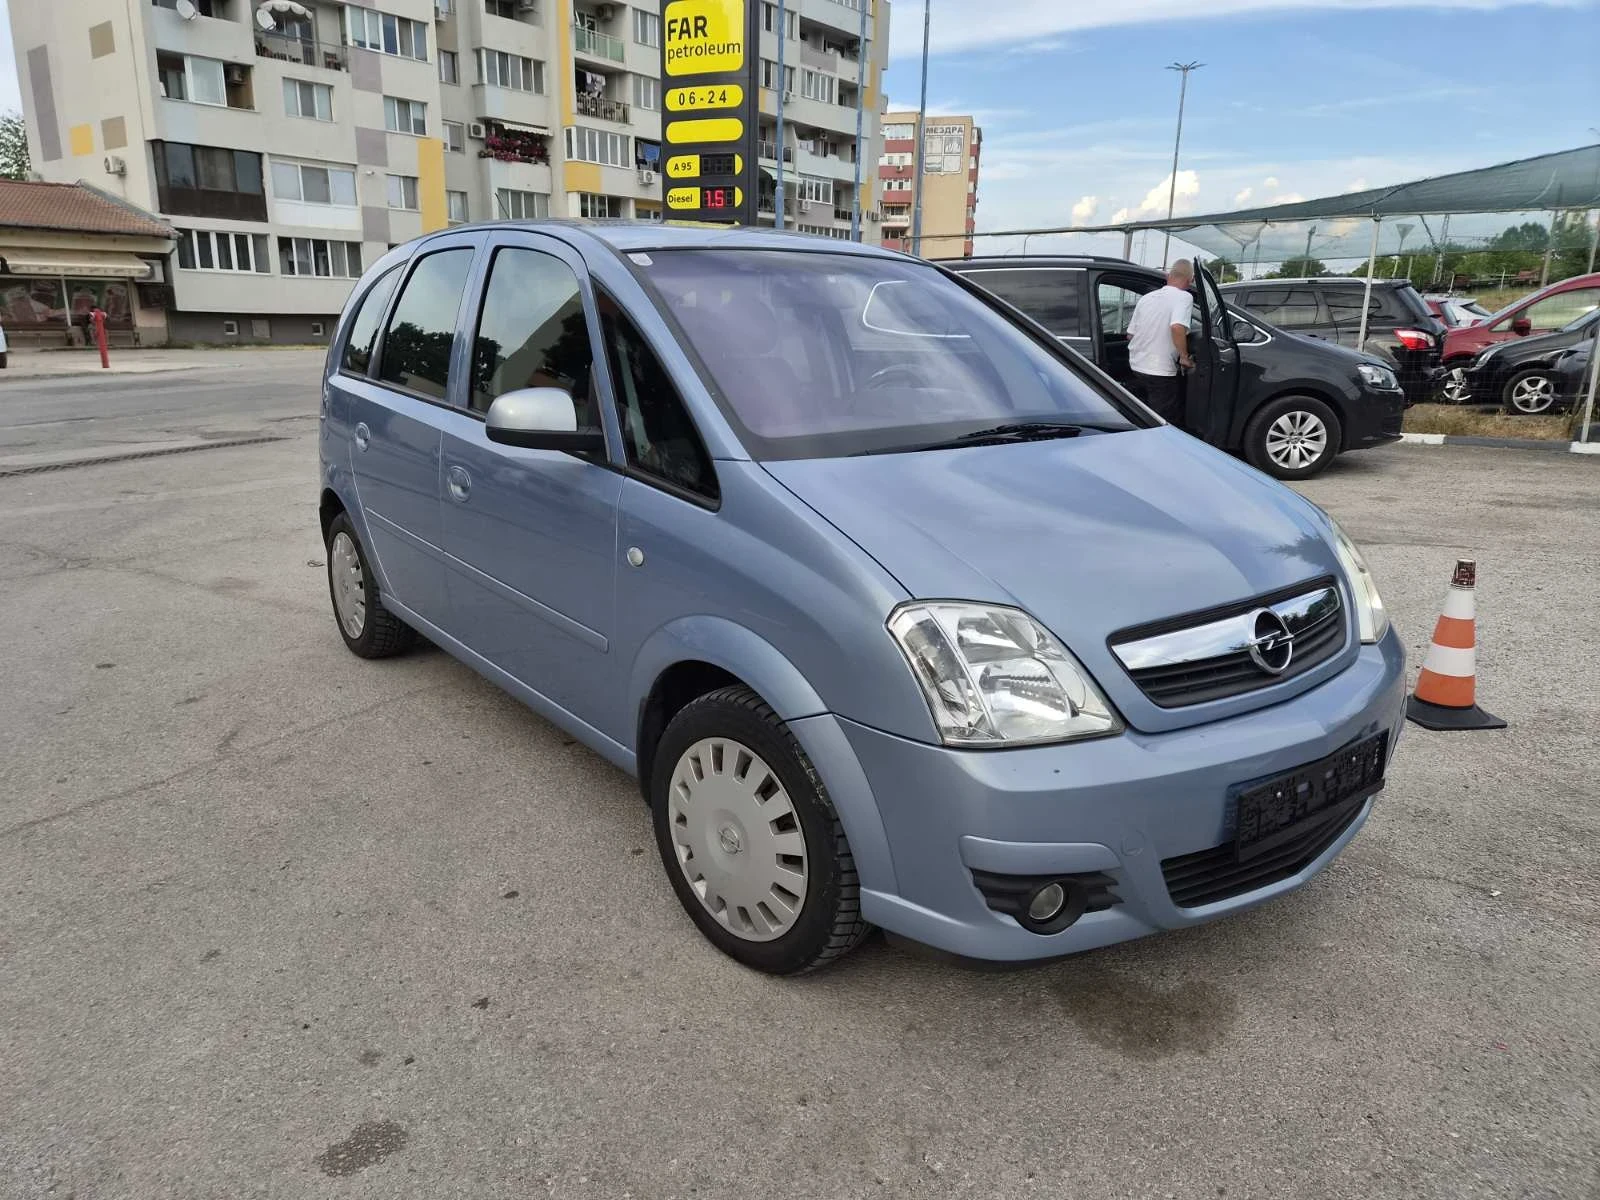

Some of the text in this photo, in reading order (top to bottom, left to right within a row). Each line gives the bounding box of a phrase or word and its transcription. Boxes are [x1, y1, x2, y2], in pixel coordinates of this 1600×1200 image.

[667, 15, 708, 41] FAR
[667, 42, 741, 64] petroleum
[681, 162, 692, 171] 95
[668, 194, 693, 203] Diesel
